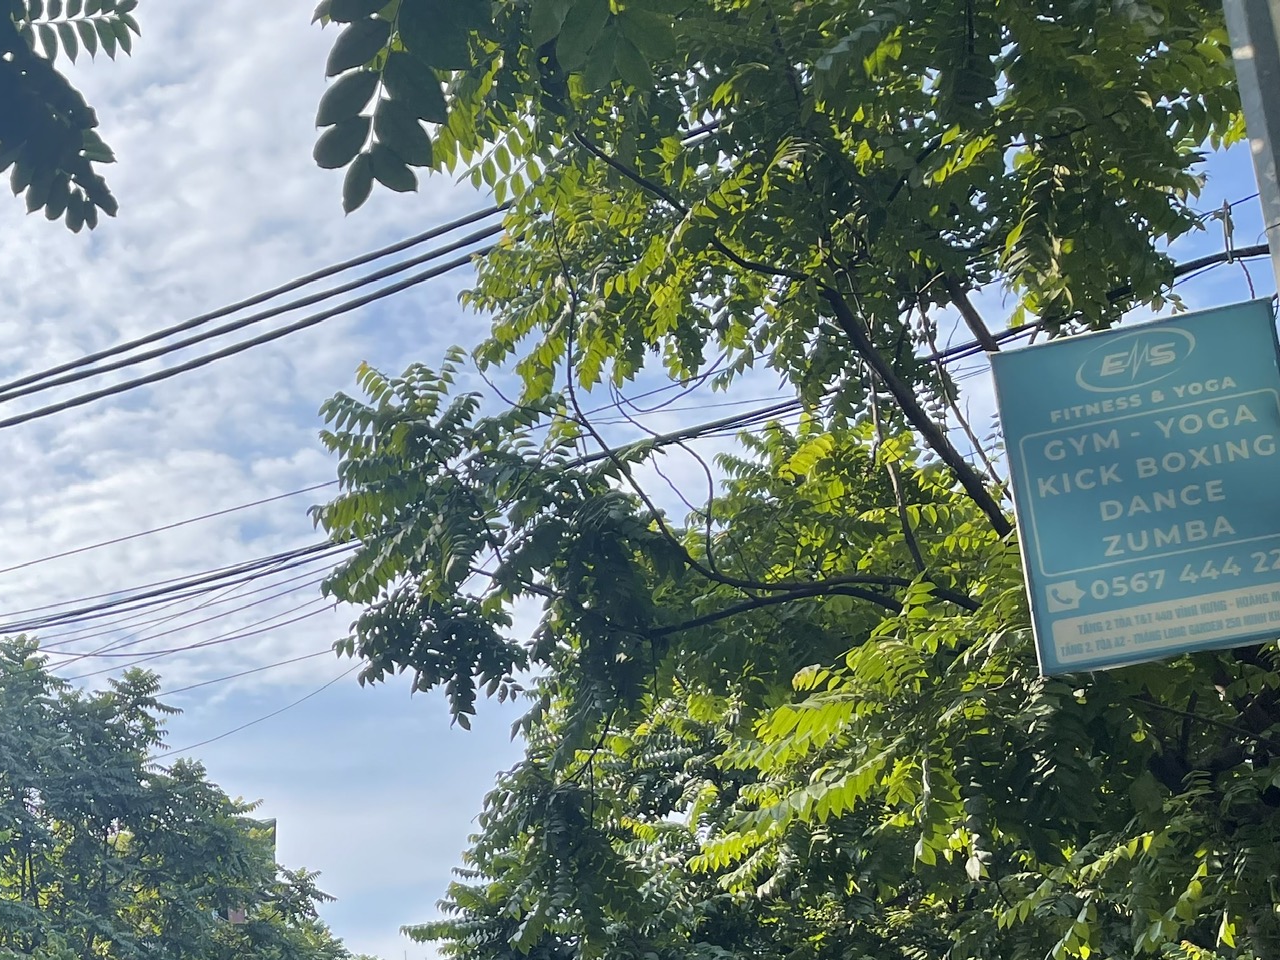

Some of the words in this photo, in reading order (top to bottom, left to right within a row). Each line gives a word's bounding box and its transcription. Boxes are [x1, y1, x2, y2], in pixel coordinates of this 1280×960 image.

[1050, 394, 1142, 424] FITNESS
[1151, 388, 1164, 403] &
[1173, 376, 1238, 398] YOGA
[1043, 428, 1120, 461] GYM
[1154, 404, 1257, 439] YOGA
[1038, 462, 1124, 498] KICK
[1136, 434, 1277, 479] BOXING
[1099, 479, 1227, 522] DANCE
[1102, 515, 1236, 558] ZUMBA
[1090, 568, 1166, 600] 0567
[1178, 555, 1242, 584] 444
